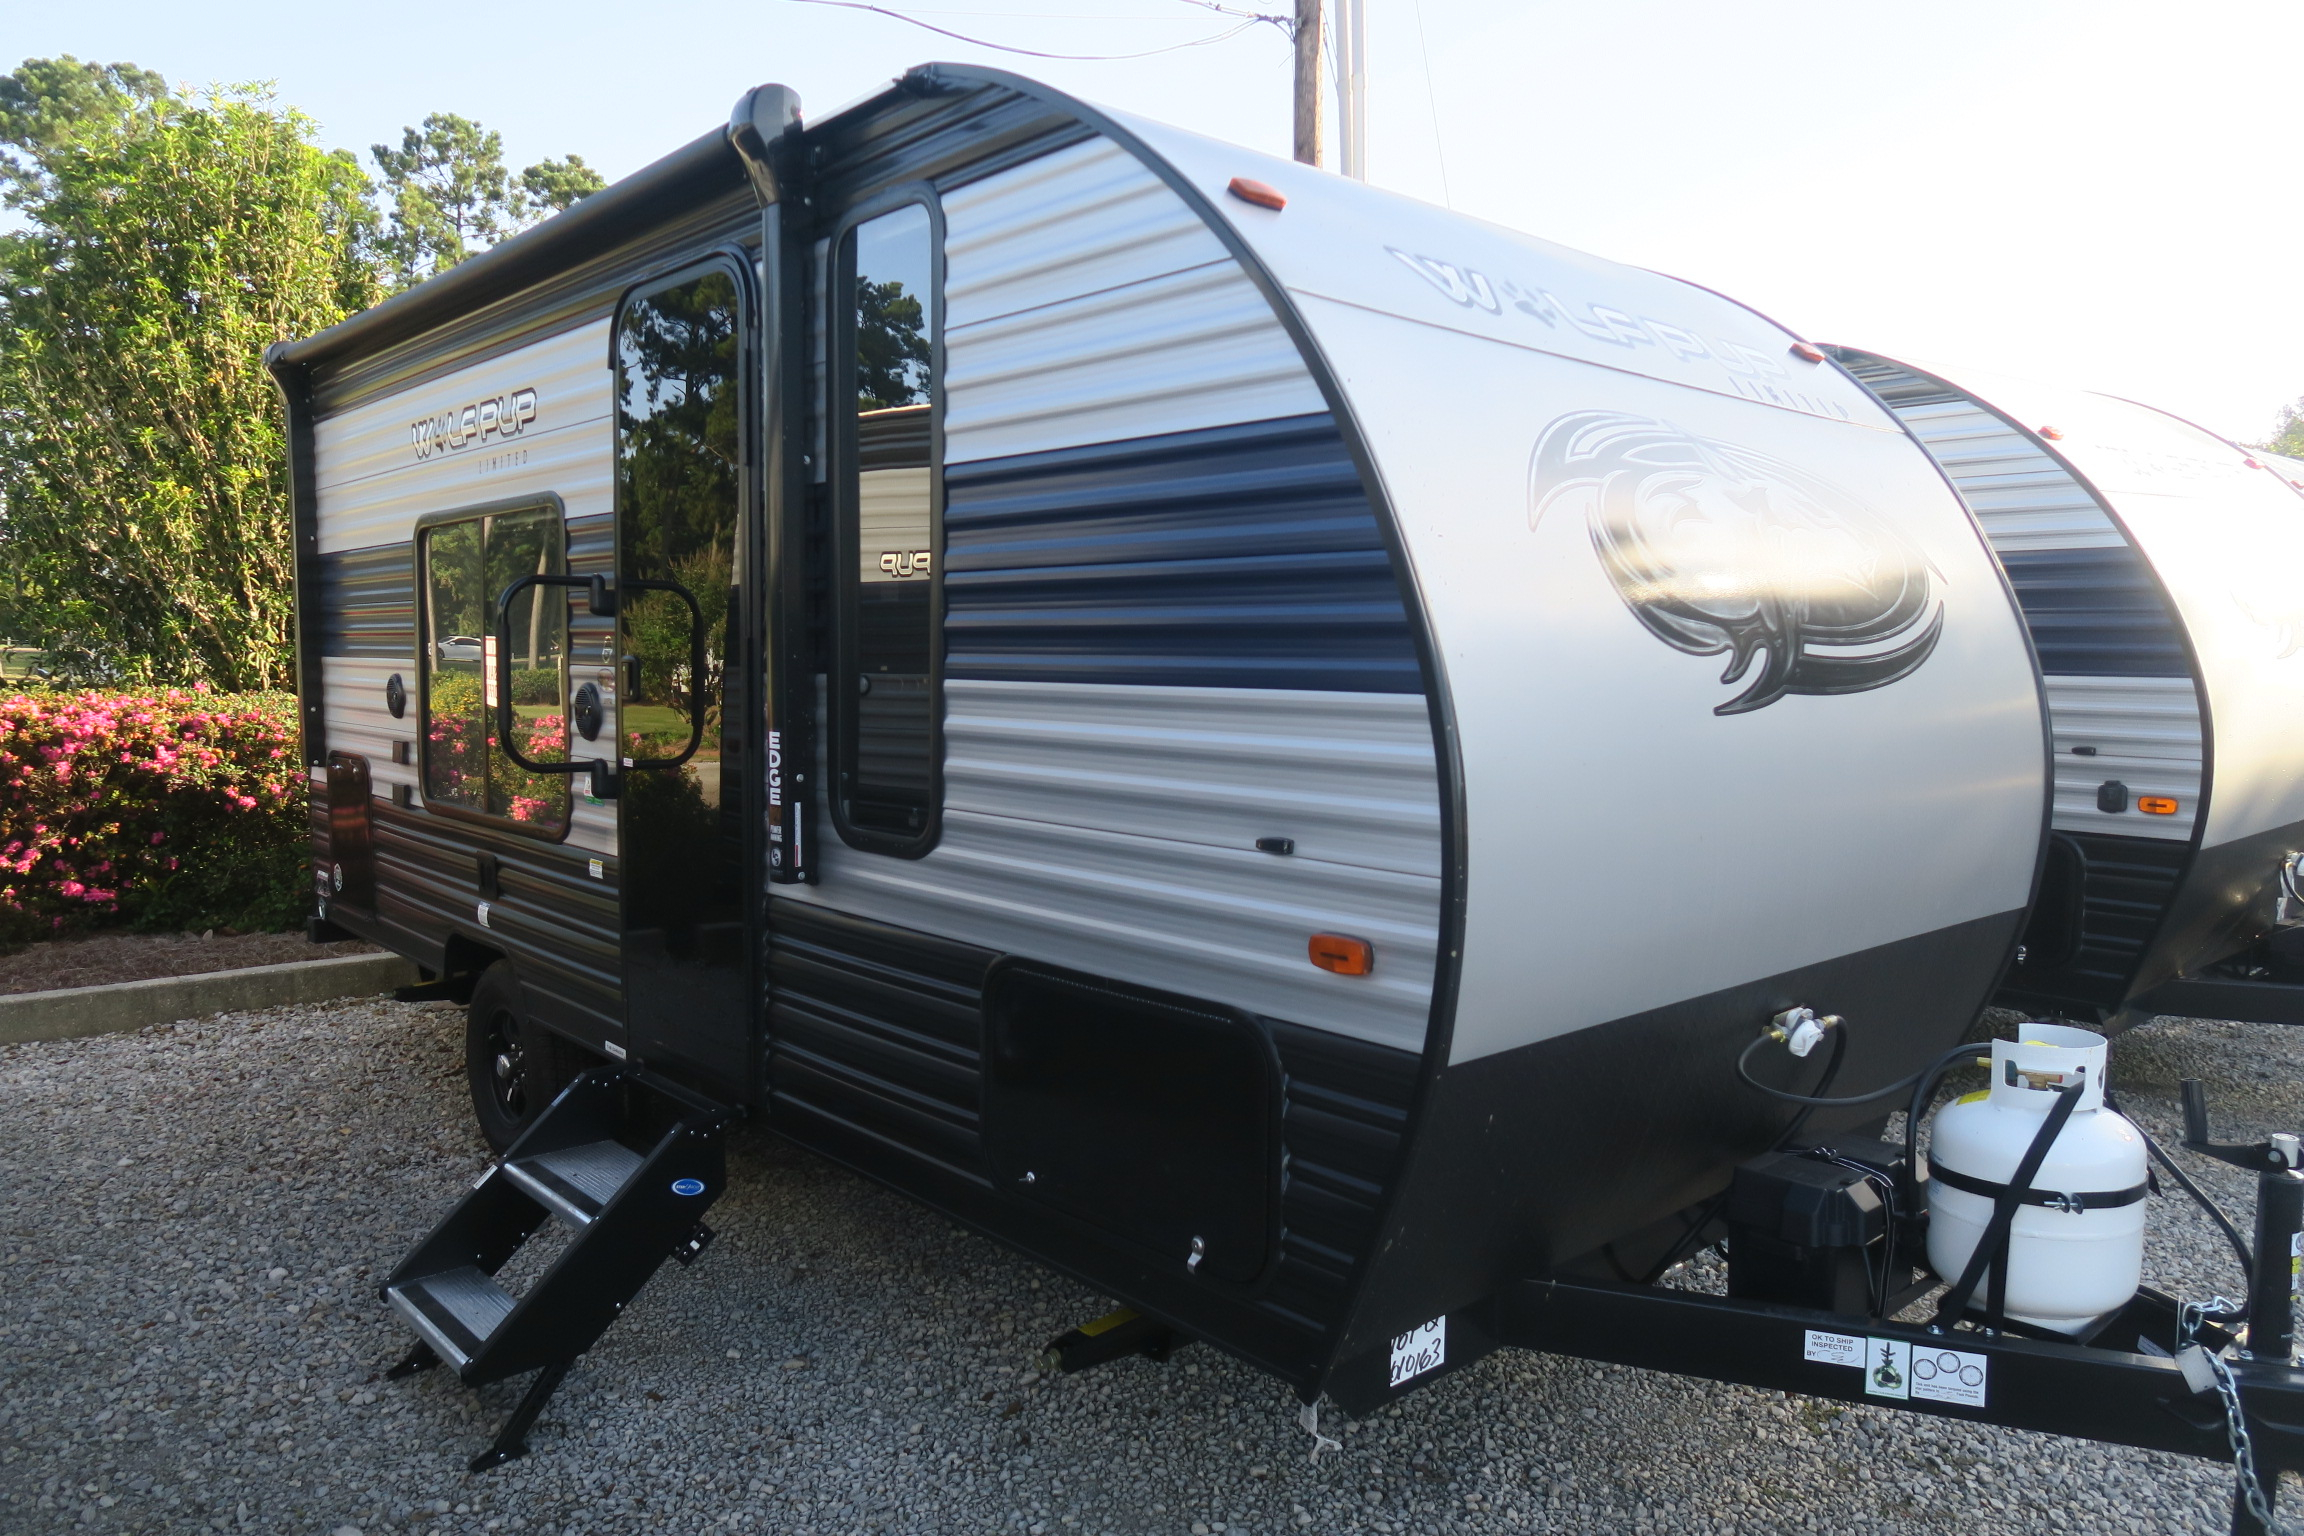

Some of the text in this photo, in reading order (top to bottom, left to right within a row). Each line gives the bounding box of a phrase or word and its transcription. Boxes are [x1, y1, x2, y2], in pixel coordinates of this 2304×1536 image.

[479, 450, 528, 474] LIMITED
[768, 731, 782, 806] EDGE
[1811, 1341, 1853, 1352] INSPECTED
